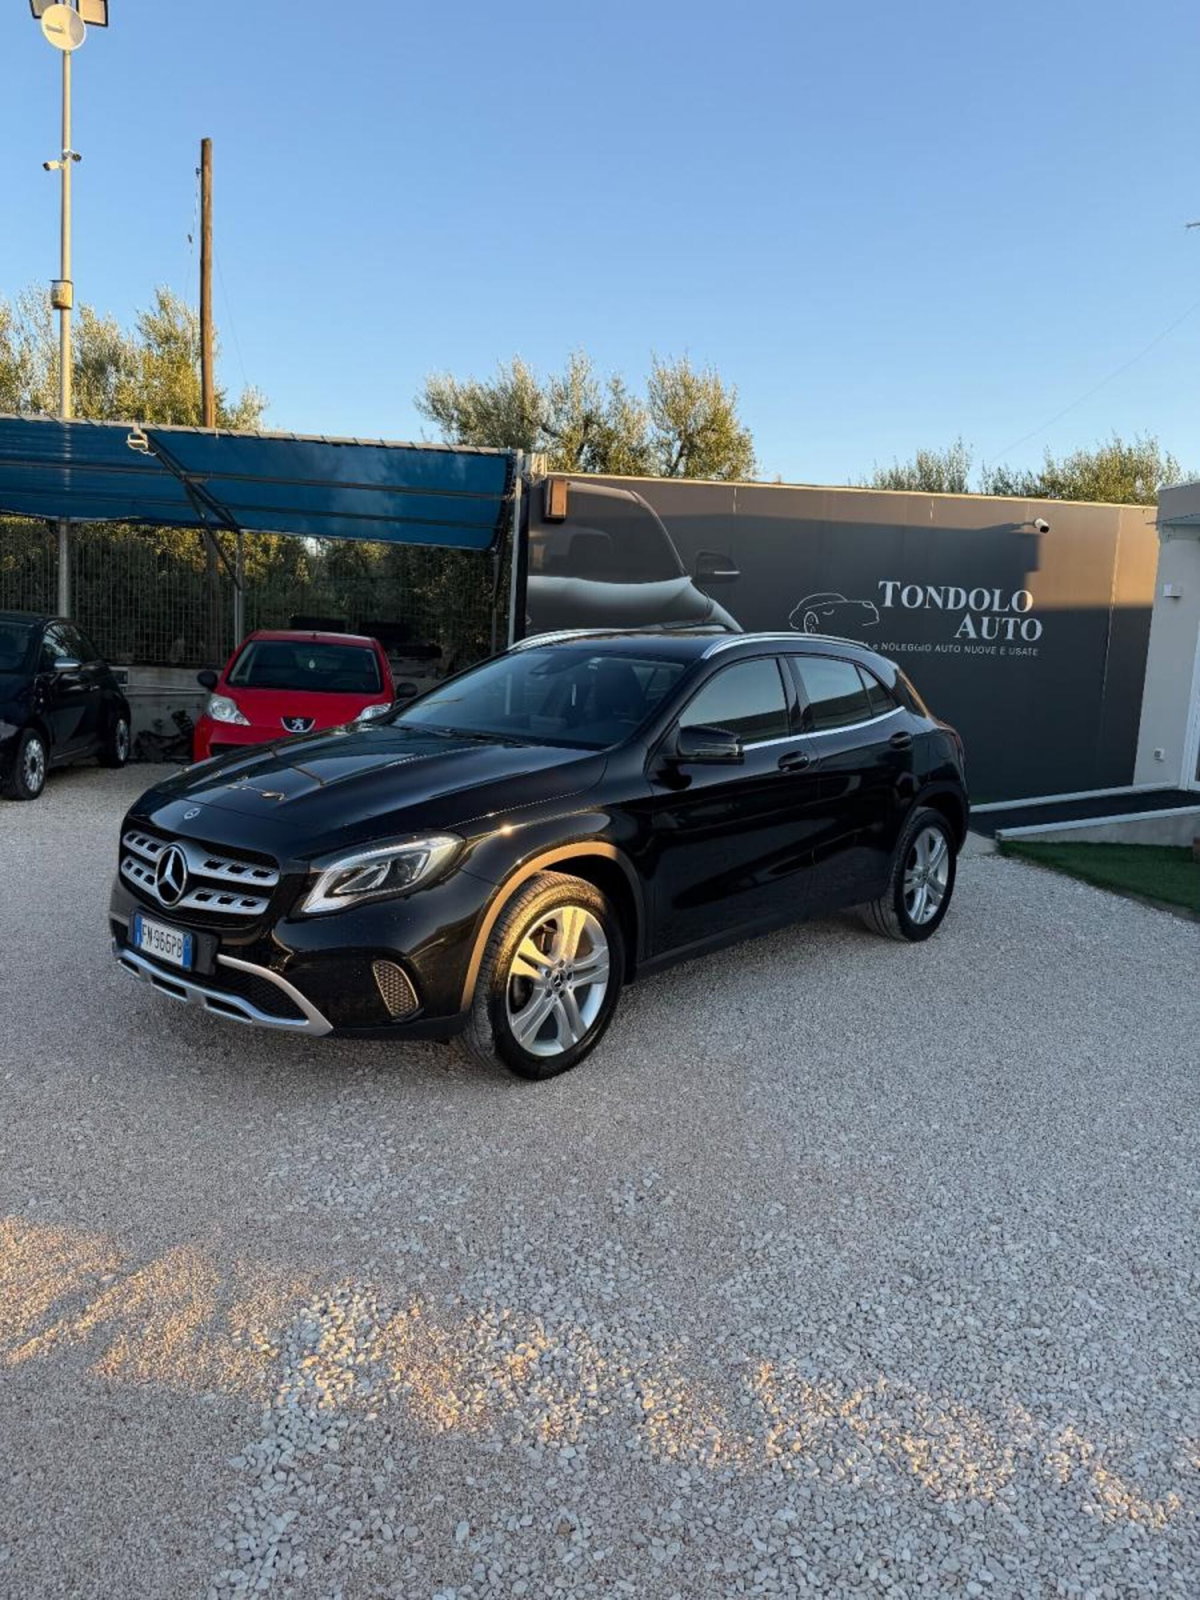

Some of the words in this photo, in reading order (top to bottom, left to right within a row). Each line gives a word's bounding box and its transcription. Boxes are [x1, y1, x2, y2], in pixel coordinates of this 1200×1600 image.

[878, 580, 1034, 613] TONDOLO
[952, 612, 1043, 642] AUTO
[934, 643, 961, 653] AUTO
